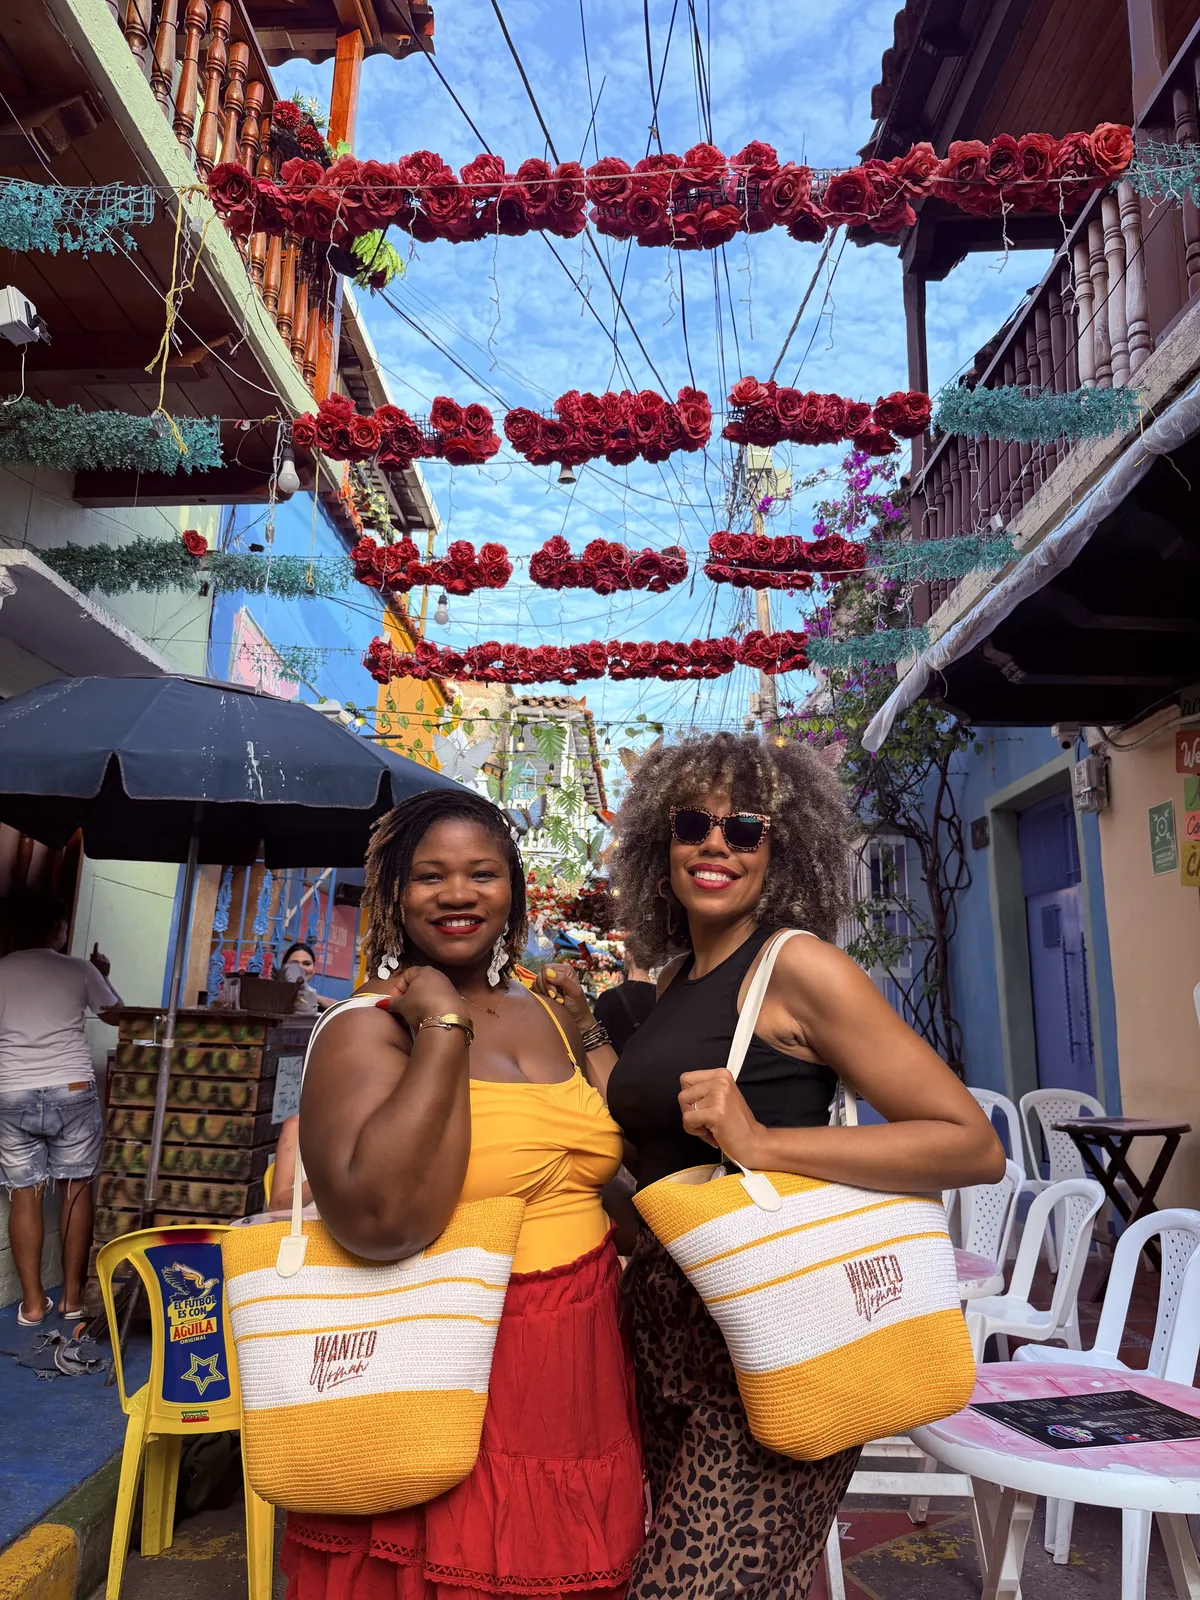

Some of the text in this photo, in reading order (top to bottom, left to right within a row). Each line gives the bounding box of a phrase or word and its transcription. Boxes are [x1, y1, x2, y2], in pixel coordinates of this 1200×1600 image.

[843, 1254, 903, 1294] WANTED
[174, 1300, 183, 1310] EL
[178, 1306, 207, 1318] ES CON
[180, 1335, 207, 1345] ORIGINAL
[313, 1330, 377, 1363] WANTED
